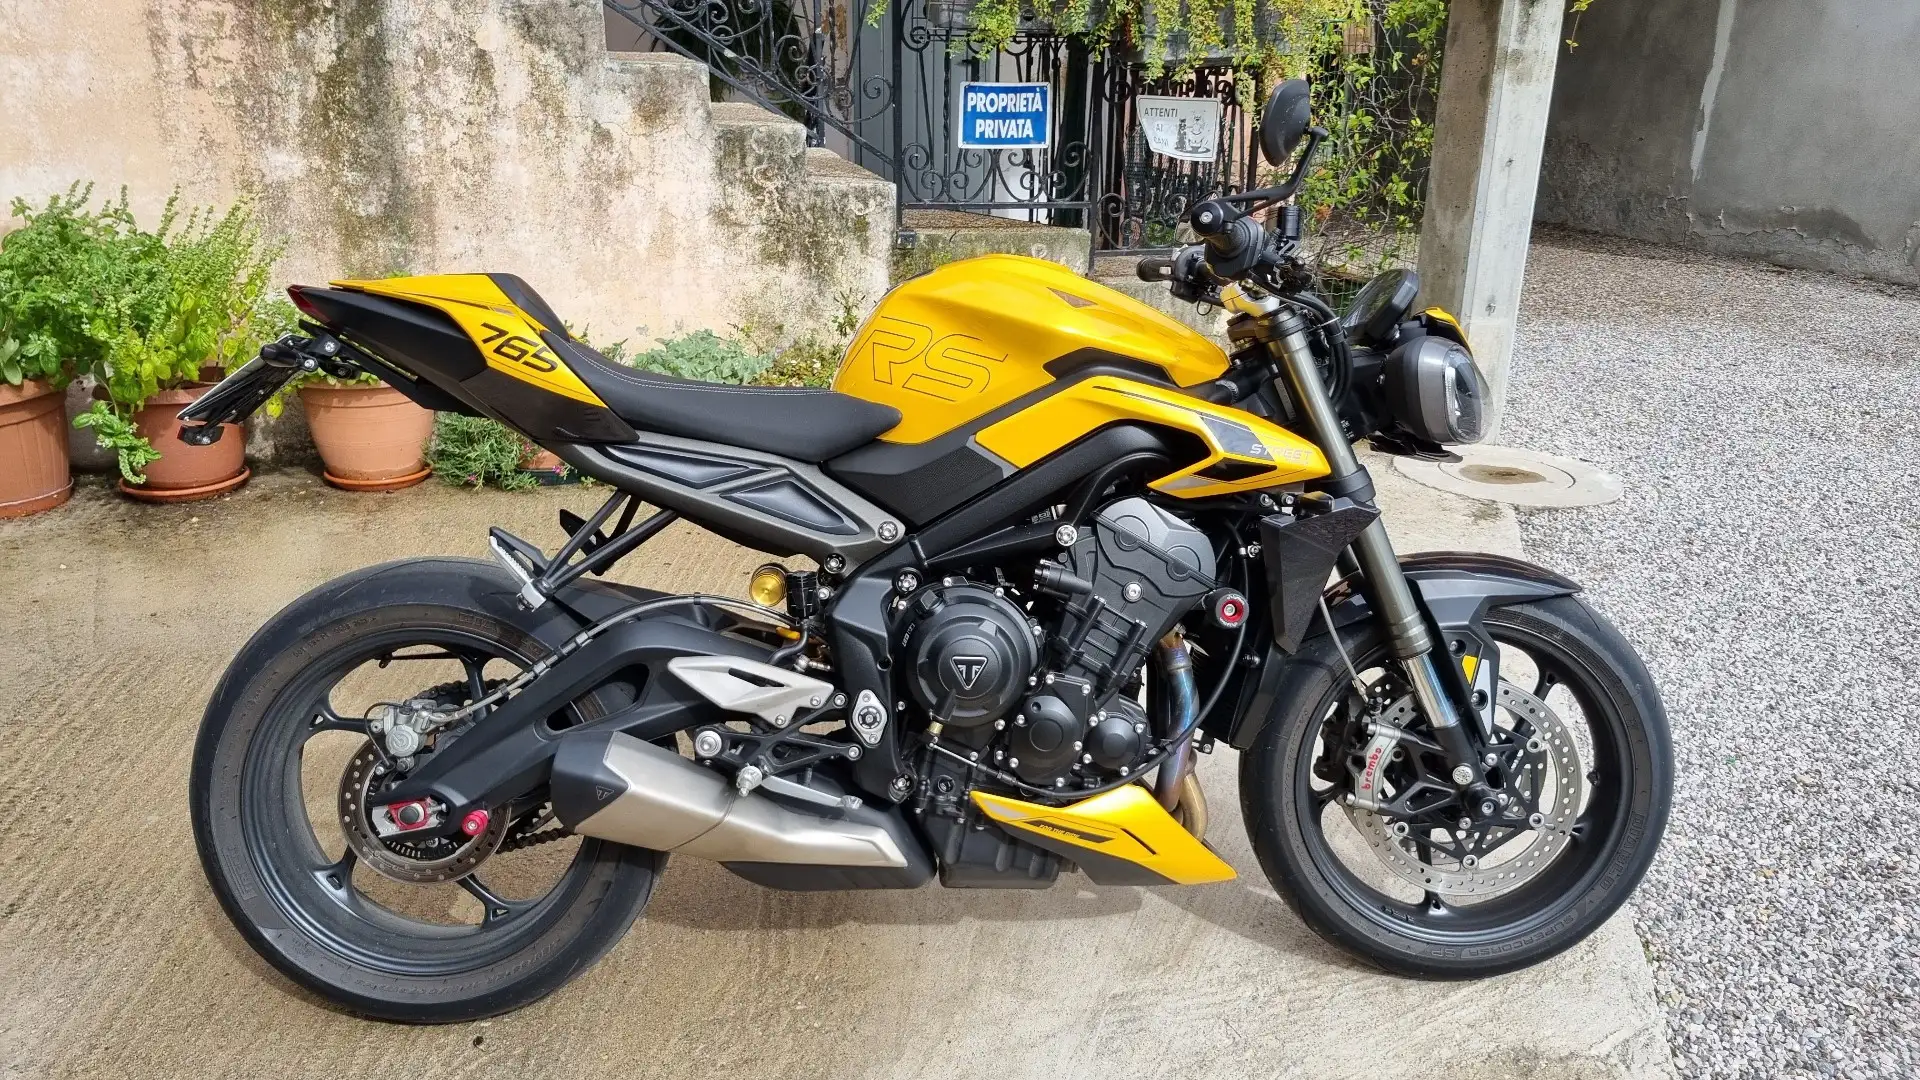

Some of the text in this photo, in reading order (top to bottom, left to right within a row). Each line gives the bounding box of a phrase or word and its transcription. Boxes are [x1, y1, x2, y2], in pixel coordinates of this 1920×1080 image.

[967, 87, 1044, 113] PROPRIETÀ
[1144, 107, 1178, 117] ATTENTI
[975, 118, 1034, 138] PRIVATA
[480, 322, 559, 373] 765
[845, 315, 1009, 402] RS
[1249, 443, 1313, 461] STREET
[1361, 747, 1382, 790] brembo
